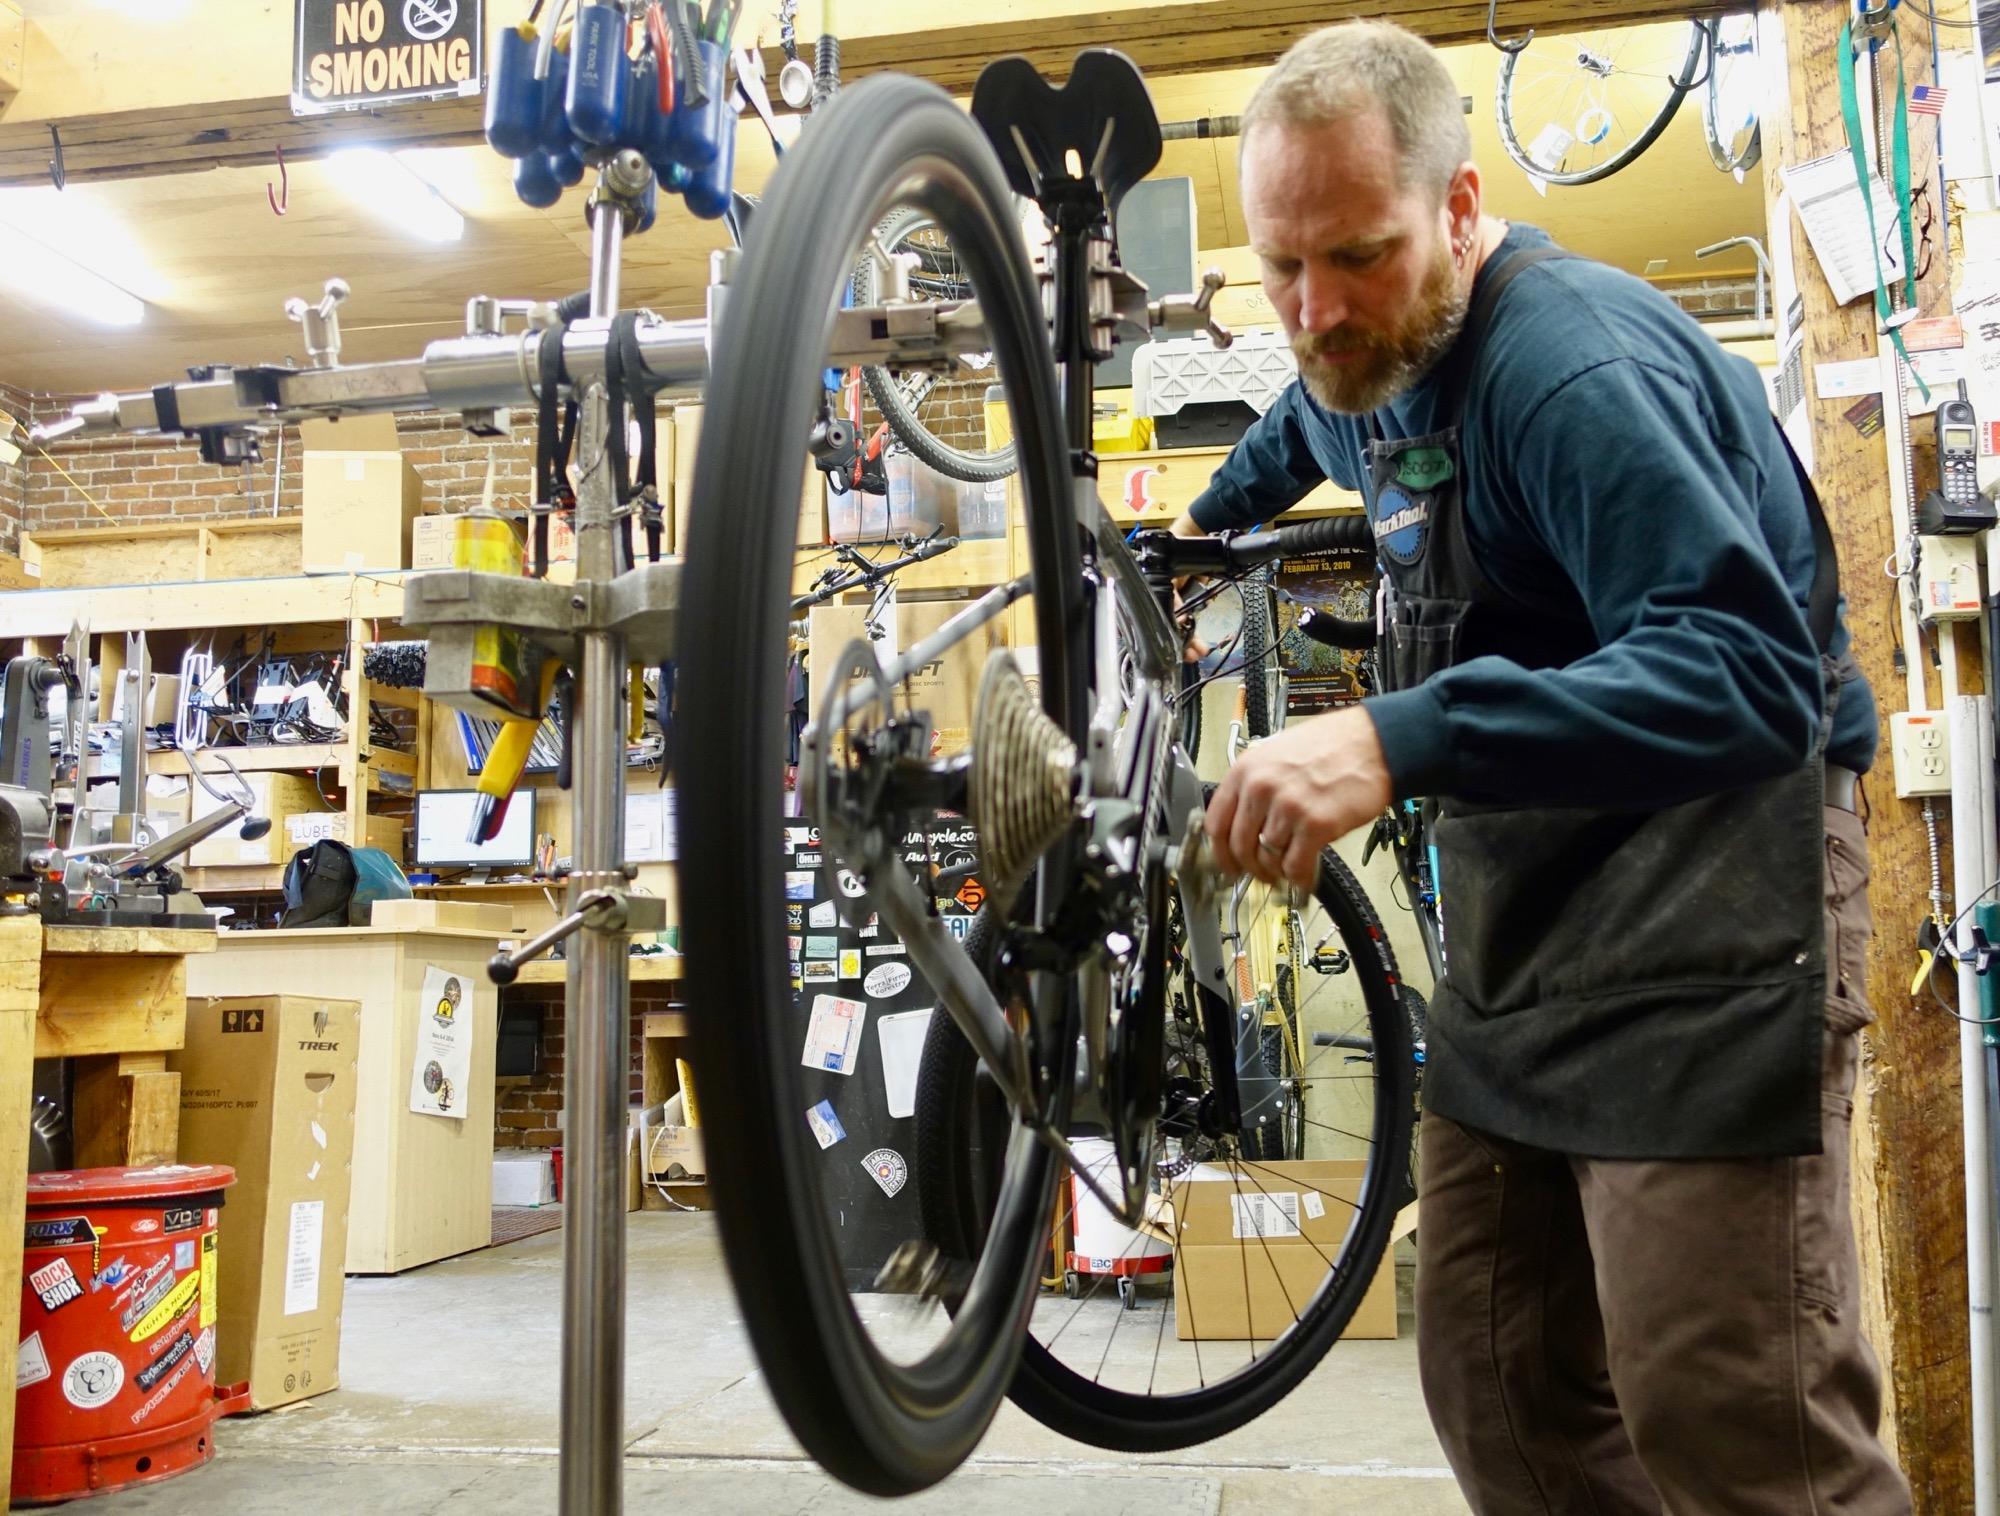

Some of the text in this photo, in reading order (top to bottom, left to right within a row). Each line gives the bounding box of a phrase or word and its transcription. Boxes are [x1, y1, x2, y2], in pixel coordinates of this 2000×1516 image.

[335, 0, 385, 45] NO
[309, 37, 470, 98] SMOKING
[1283, 561, 1351, 573] FEBRUARY 13, 2010
[22, 736, 32, 768] BIKES
[295, 825, 329, 839] LUBE
[799, 851, 822, 864] ÖHLIN
[875, 979, 907, 995] Forestry
[298, 1041, 340, 1051] TREK
[1091, 1259, 1111, 1268] EBC
[33, 1261, 70, 1293] ROCK
[42, 1277, 81, 1310] SHOX
